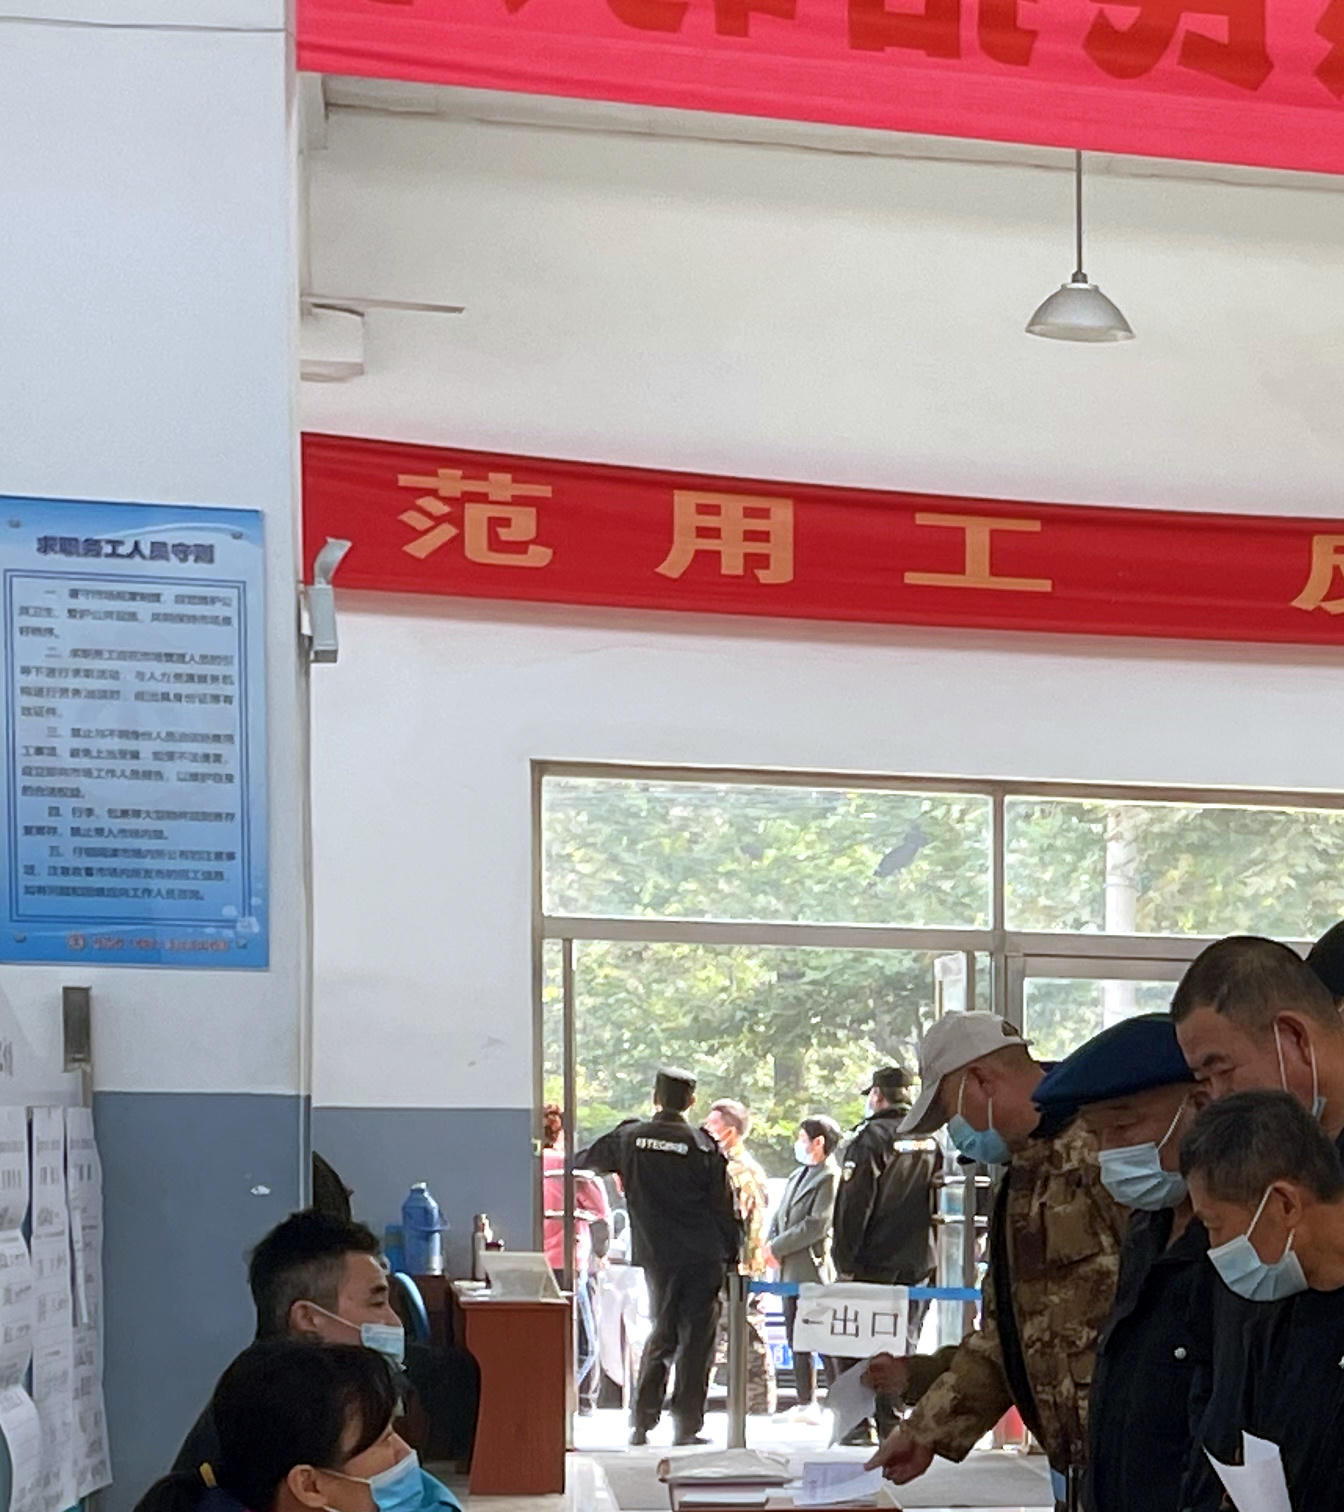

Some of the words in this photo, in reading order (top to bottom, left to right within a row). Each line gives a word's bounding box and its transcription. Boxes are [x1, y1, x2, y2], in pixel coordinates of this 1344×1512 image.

[397, 468, 1053, 593] 范用工
[831, 1304, 899, 1338] 出口
